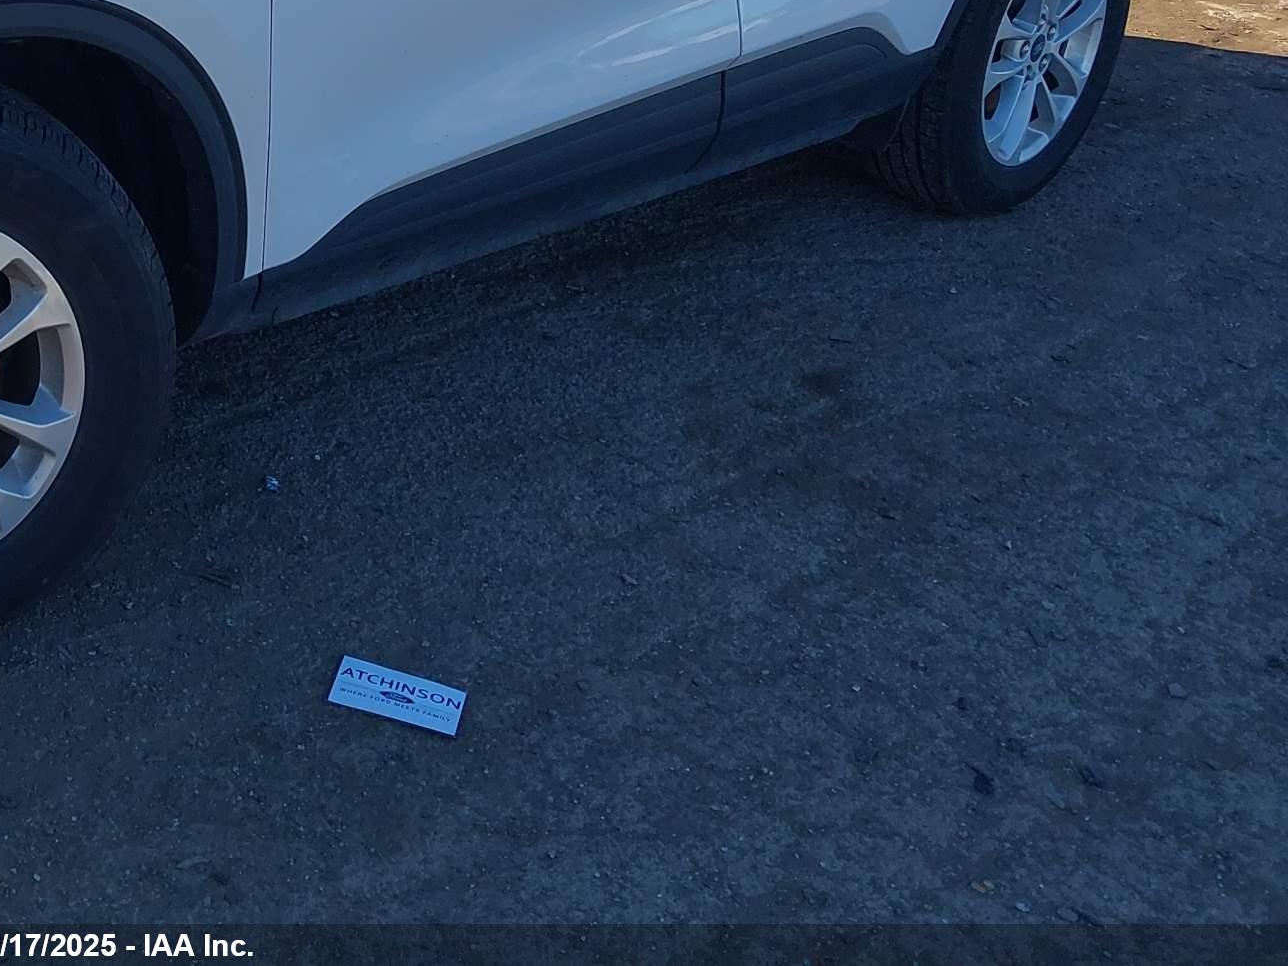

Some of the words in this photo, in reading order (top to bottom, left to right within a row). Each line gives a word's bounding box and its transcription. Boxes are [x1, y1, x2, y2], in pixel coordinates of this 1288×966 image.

[339, 686, 367, 698] WHERE
[369, 695, 392, 705] FORD
[394, 702, 420, 713] MEETS
[422, 710, 451, 723] FAMILY
[340, 667, 461, 710] ATCHINSON
